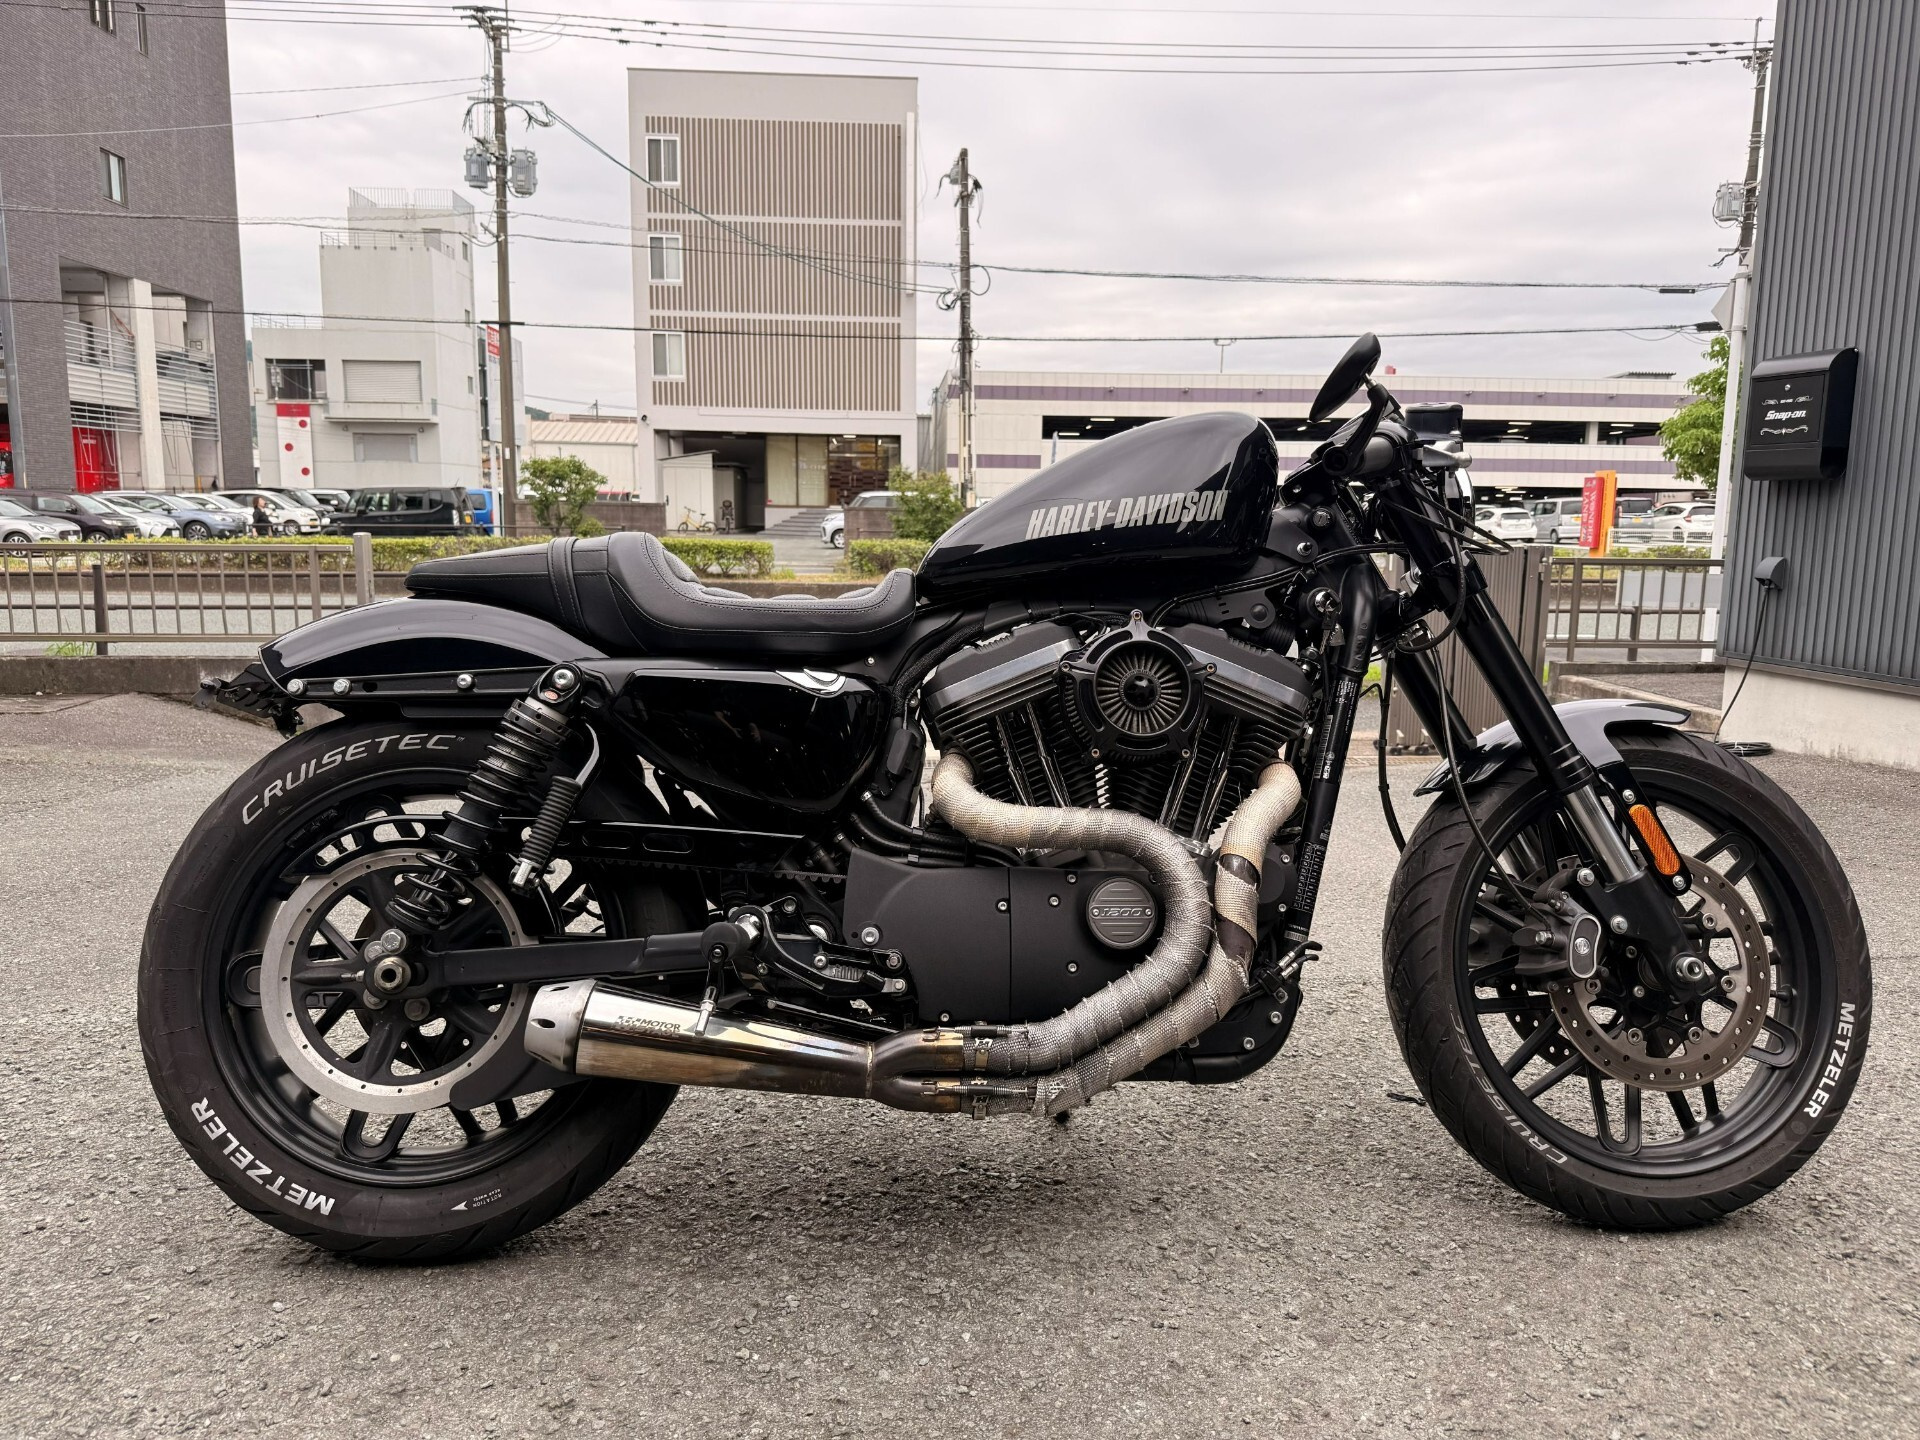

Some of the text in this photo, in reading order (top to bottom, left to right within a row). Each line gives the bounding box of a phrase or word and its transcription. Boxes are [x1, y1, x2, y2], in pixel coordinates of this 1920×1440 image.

[1764, 410, 1807, 421] Snap-on
[1025, 488, 1229, 541] HARLEY-DAVIDSON
[242, 733, 457, 826] CRUISETEC
[1101, 908, 1143, 916] 1200
[640, 1019, 681, 1031] MOTOR
[1804, 1002, 1856, 1118] METZELER
[191, 1097, 336, 1216] METZELER
[472, 1193, 502, 1207] ROTATION
